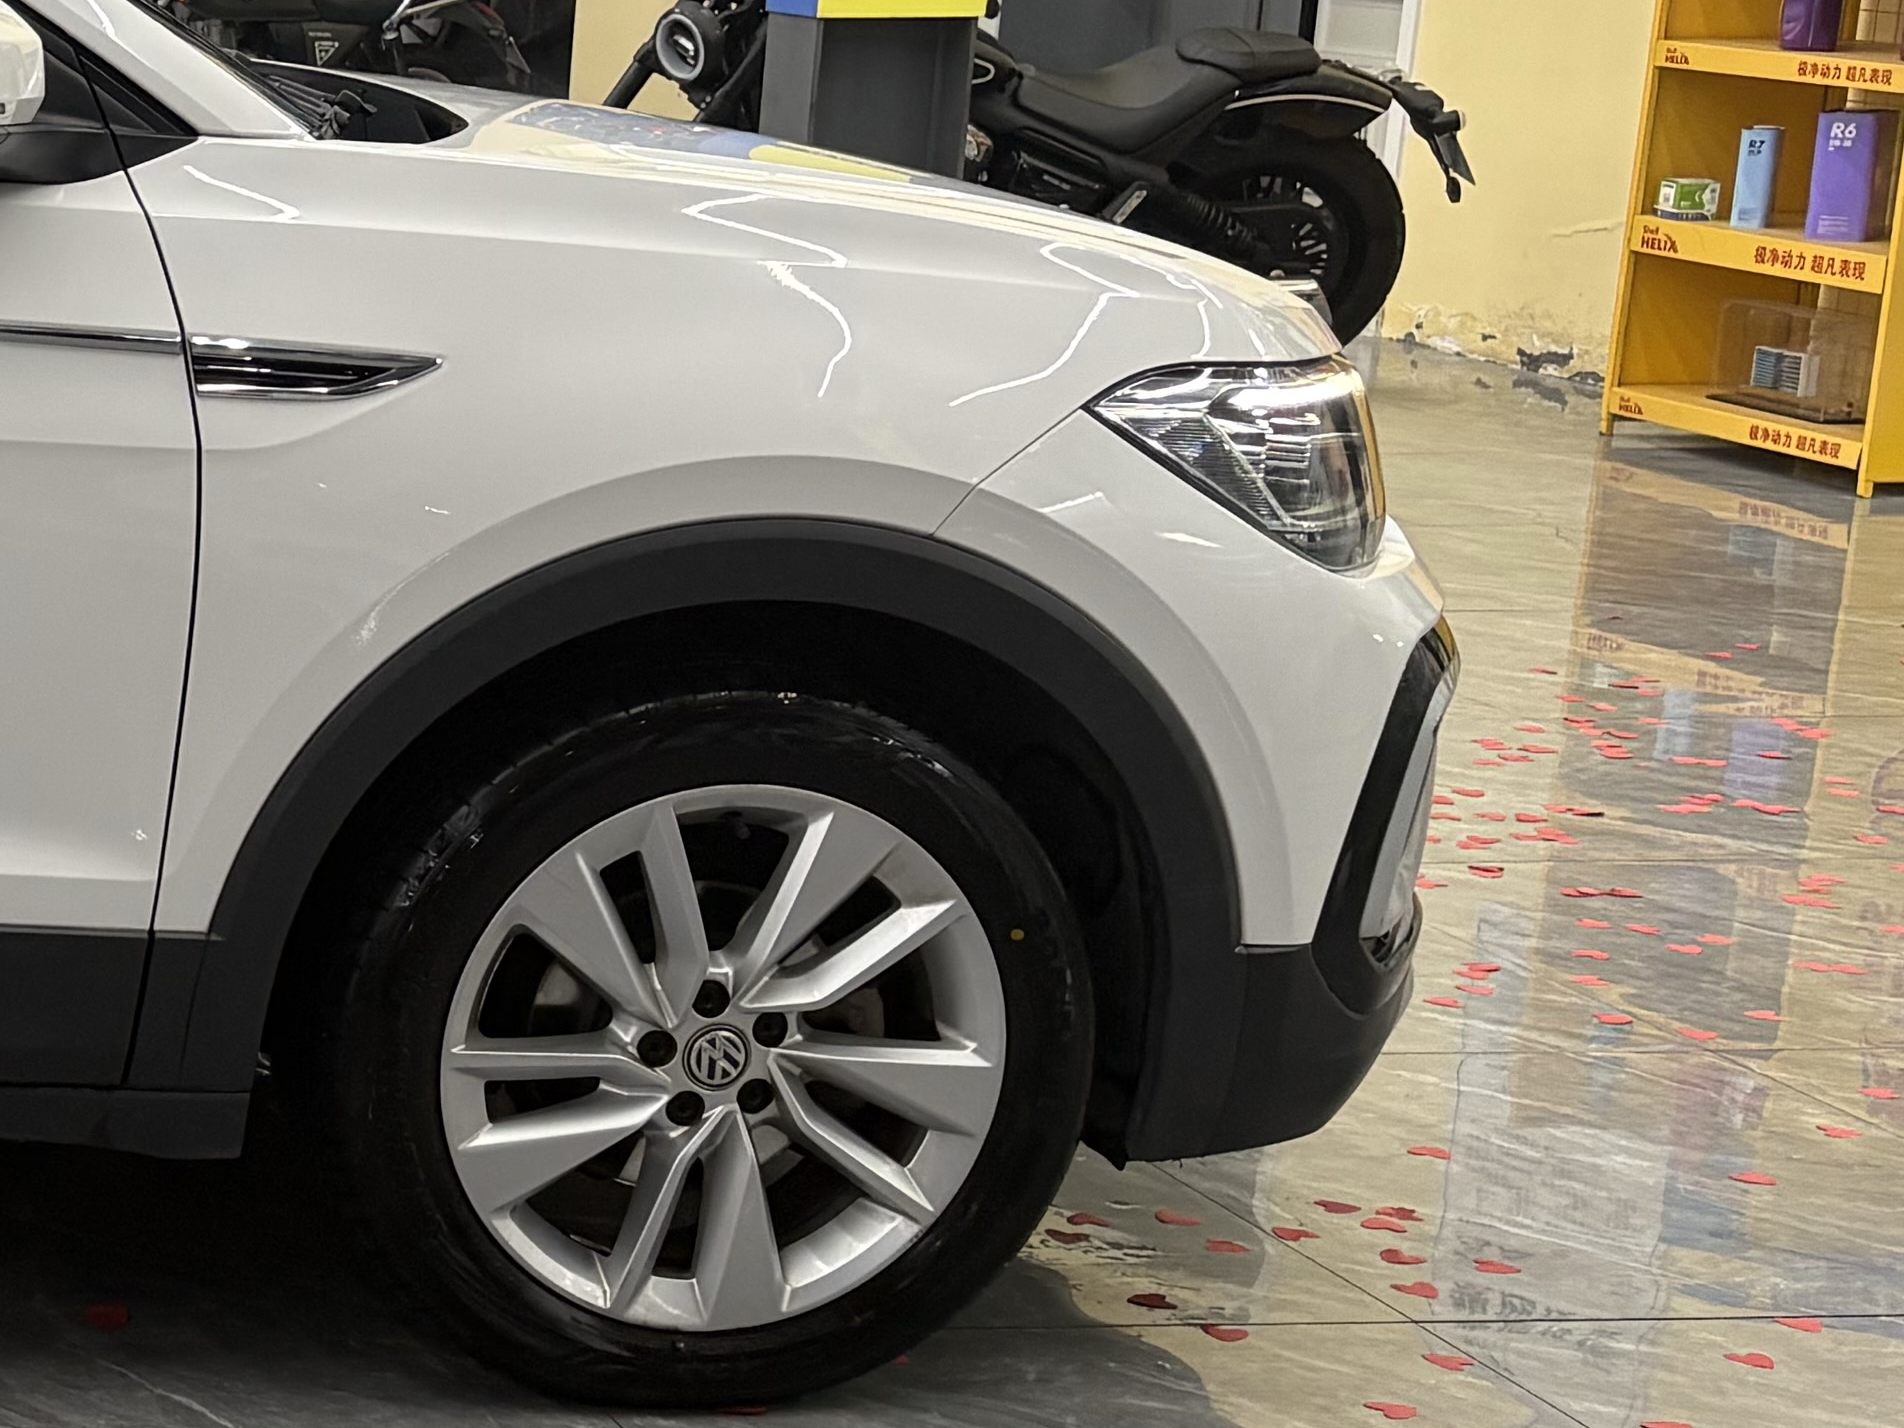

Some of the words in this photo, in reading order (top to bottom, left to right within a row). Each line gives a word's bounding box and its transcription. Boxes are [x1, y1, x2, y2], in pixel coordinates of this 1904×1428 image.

[1798, 61, 1842, 80] 极净动力
[1845, 65, 1893, 86] 超凡表现
[1830, 122, 1857, 139] R6
[1641, 232, 1679, 254] HELIX
[1754, 244, 1807, 271] 极净动力
[1810, 254, 1867, 281] 超凡表现
[1749, 424, 1792, 448] 极净动力
[1795, 434, 1842, 460] 超凡表现
